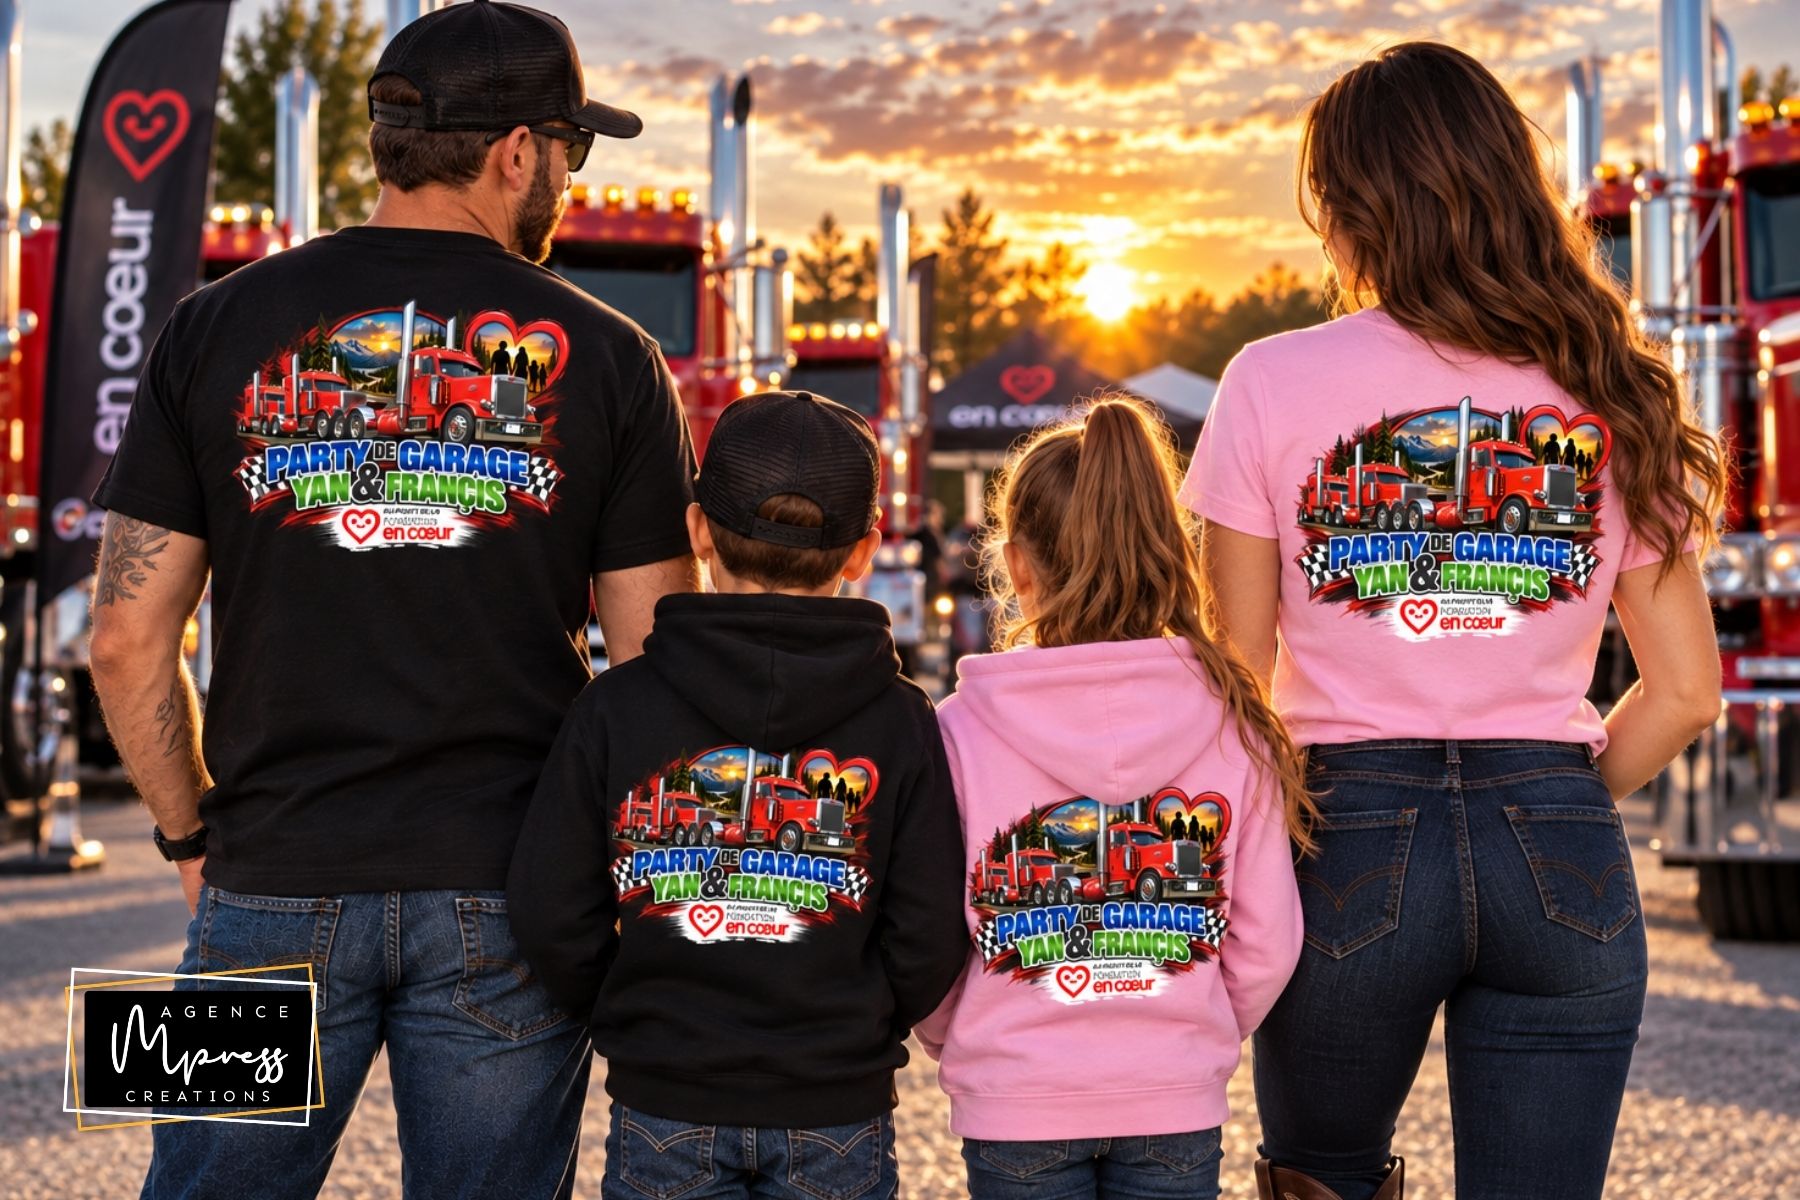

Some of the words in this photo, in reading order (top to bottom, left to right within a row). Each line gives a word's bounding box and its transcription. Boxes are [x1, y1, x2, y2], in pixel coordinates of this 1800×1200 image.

[949, 404, 997, 428] en
[265, 439, 371, 484] PARTY
[373, 441, 396, 461] DE
[397, 440, 530, 486] GARAGE
[289, 472, 351, 511] YAN
[351, 461, 385, 503] &
[383, 527, 405, 540] en
[1328, 531, 1429, 572] PARTY
[1430, 533, 1452, 553] DE
[1452, 533, 1574, 574] GARAGE
[1353, 561, 1409, 599] YAN
[1409, 553, 1441, 593] &
[1439, 617, 1461, 630] en
[632, 847, 720, 881] PARTY
[720, 849, 740, 866] DE
[740, 848, 848, 888] GARAGE
[651, 873, 701, 904] YAN
[700, 865, 728, 900] &
[725, 922, 746, 934] en
[995, 903, 1080, 945] PARTY
[1081, 905, 1101, 923] DE
[1102, 903, 1207, 938] GARAGE
[1016, 933, 1064, 969] YAN
[1064, 923, 1093, 962] &
[1092, 980, 1113, 993] en
